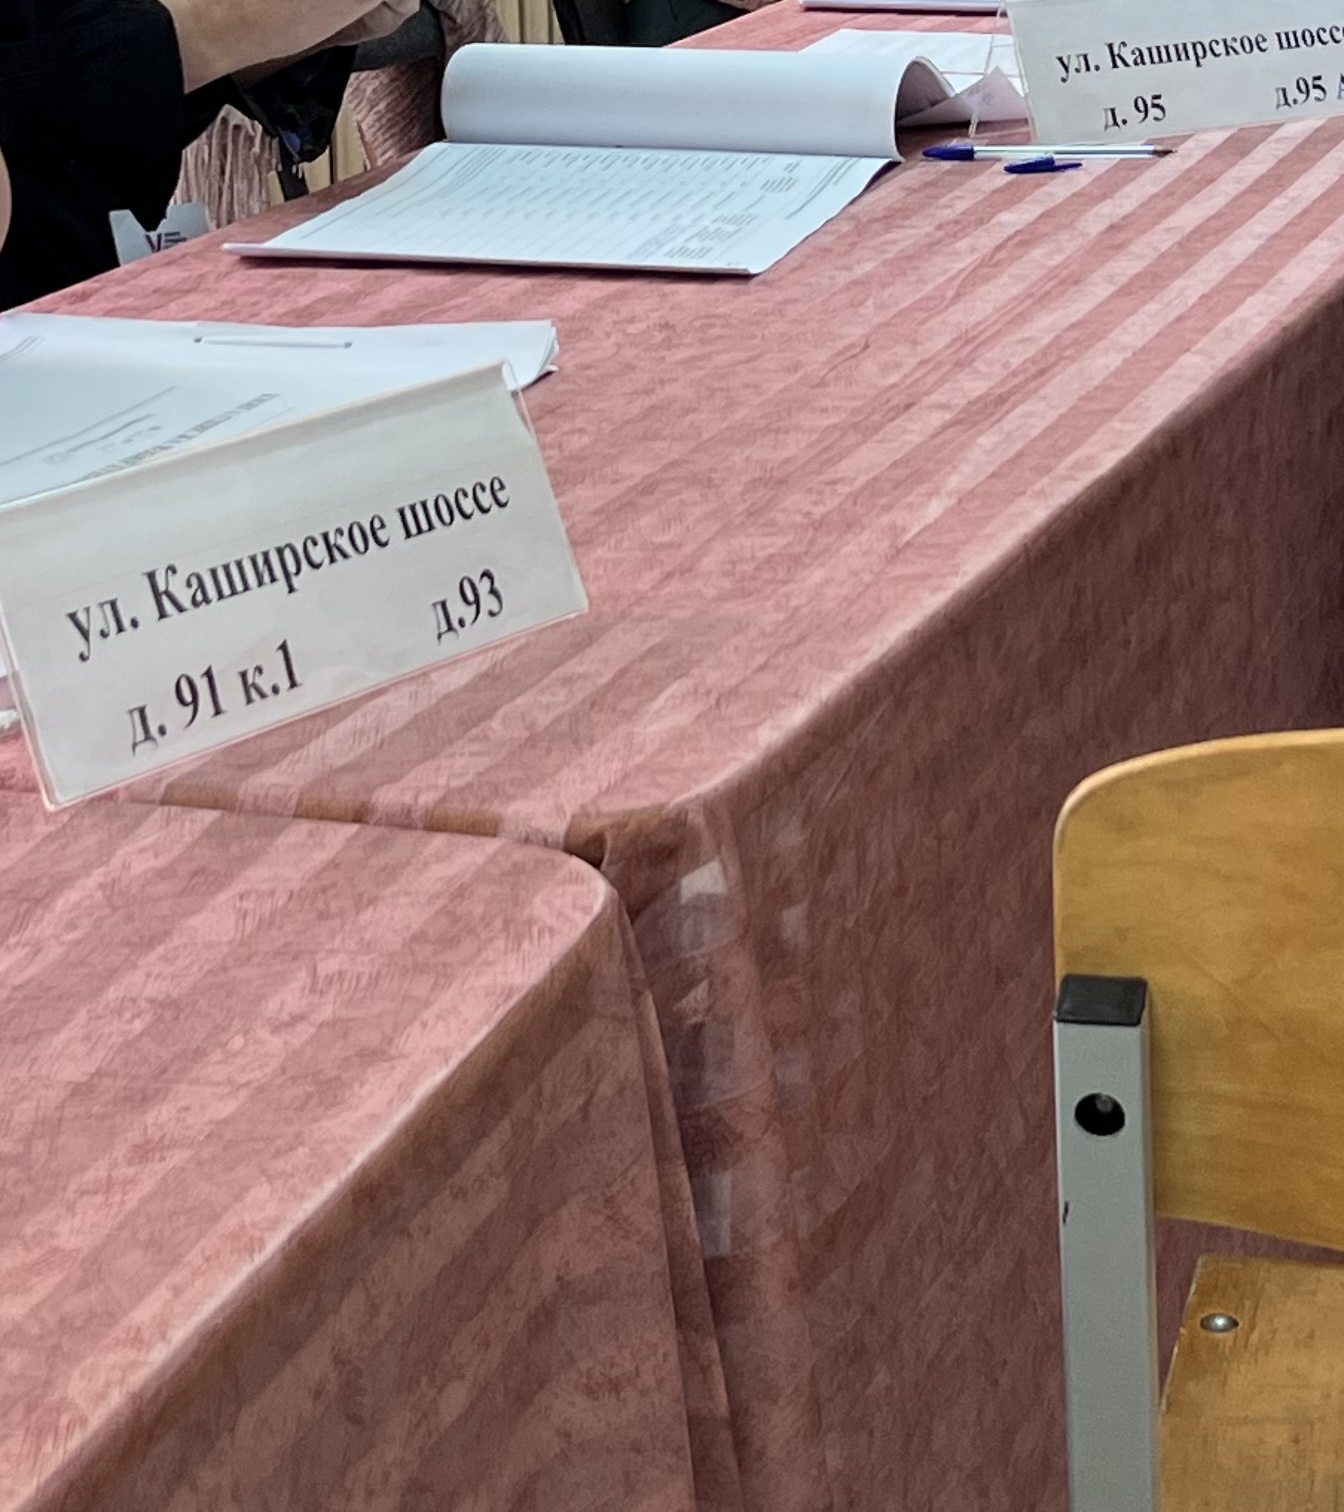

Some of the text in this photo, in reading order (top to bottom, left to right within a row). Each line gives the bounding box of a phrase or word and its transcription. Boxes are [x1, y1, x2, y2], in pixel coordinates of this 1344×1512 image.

[1055, 50, 1101, 84] ул.
[1105, 33, 1269, 70] Каширское
[1103, 93, 1168, 132] д. 95
[1274, 74, 1328, 111] д.95
[66, 474, 511, 663] ул. Каширское шоссе
[430, 568, 505, 645] д.93
[126, 638, 305, 757] д. 91 к.1
